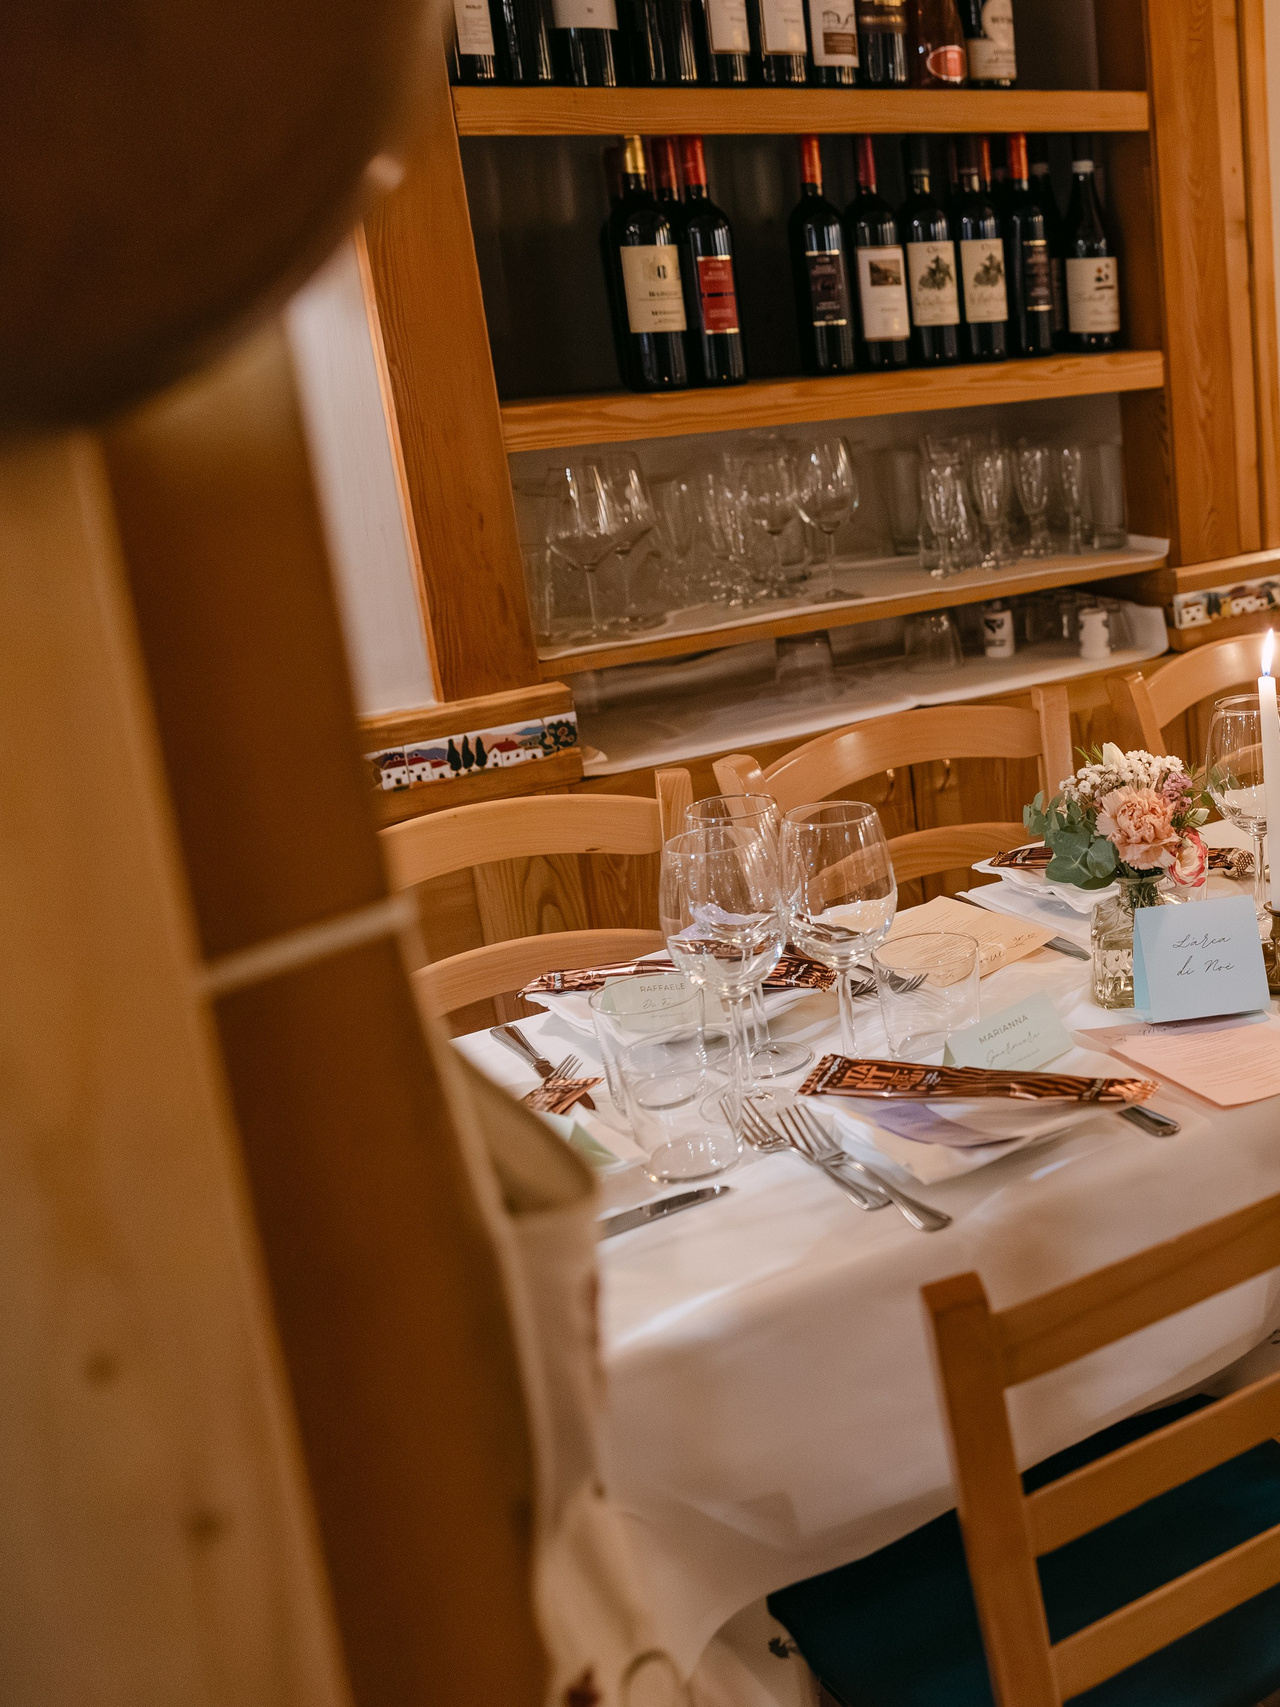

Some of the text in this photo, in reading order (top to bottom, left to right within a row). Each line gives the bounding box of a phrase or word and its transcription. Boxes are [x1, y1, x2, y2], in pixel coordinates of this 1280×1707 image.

[1172, 933, 1232, 949] L'arca
[1177, 955, 1195, 976] di
[640, 983, 686, 993] RAFFAELE
[978, 1014, 1029, 1045] MARIANNA
